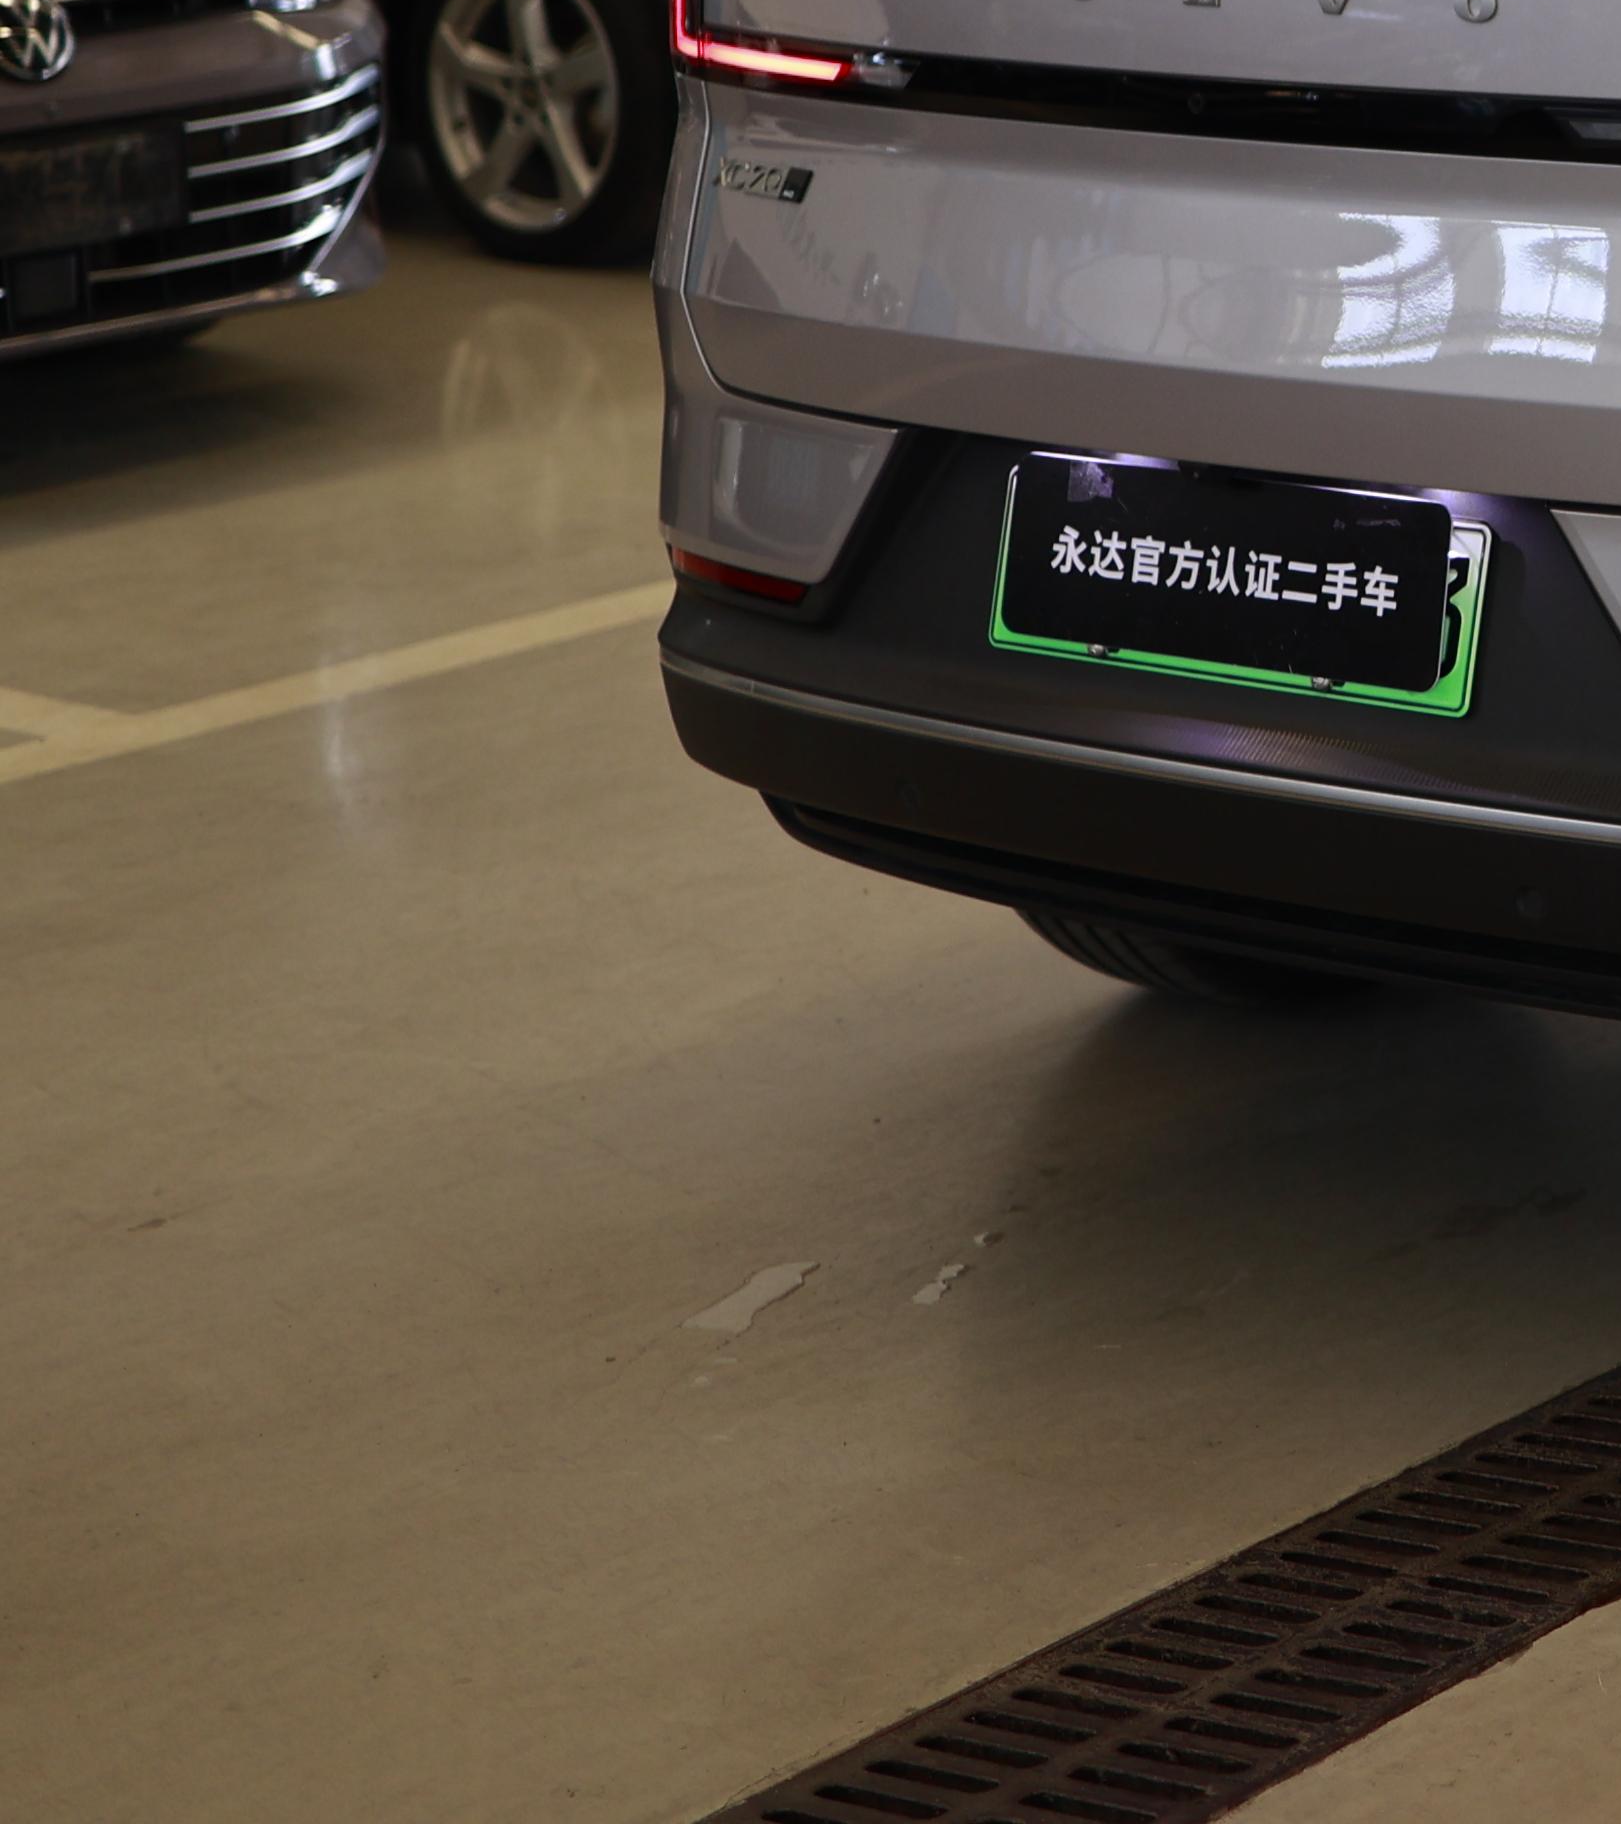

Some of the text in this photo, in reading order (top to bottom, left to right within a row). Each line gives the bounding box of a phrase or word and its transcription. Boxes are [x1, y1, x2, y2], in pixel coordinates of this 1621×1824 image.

[1051, 525, 1399, 617] 永达官方认证二手车
